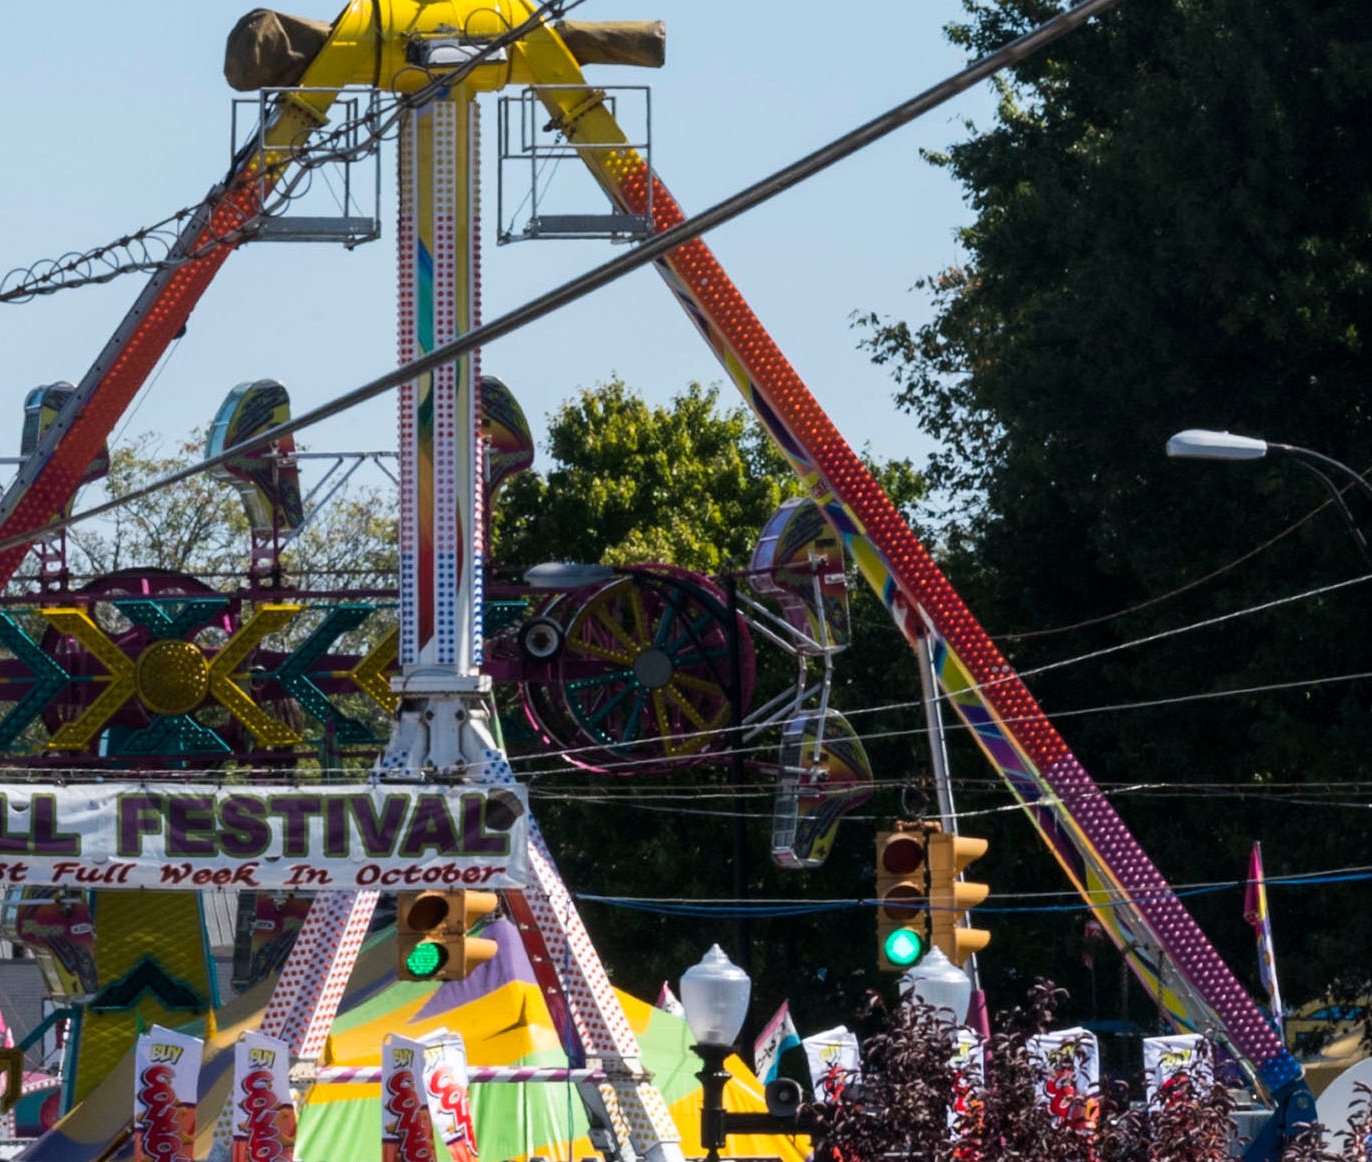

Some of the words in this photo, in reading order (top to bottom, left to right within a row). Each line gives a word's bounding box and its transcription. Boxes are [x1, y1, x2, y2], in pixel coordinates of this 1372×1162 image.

[117, 792, 512, 860] FESTIVAL
[52, 861, 134, 885] Full
[160, 862, 263, 887] Week
[291, 862, 333, 886] In
[354, 862, 507, 887] October
[151, 1043, 184, 1064] BUY
[248, 1049, 276, 1068] BUY
